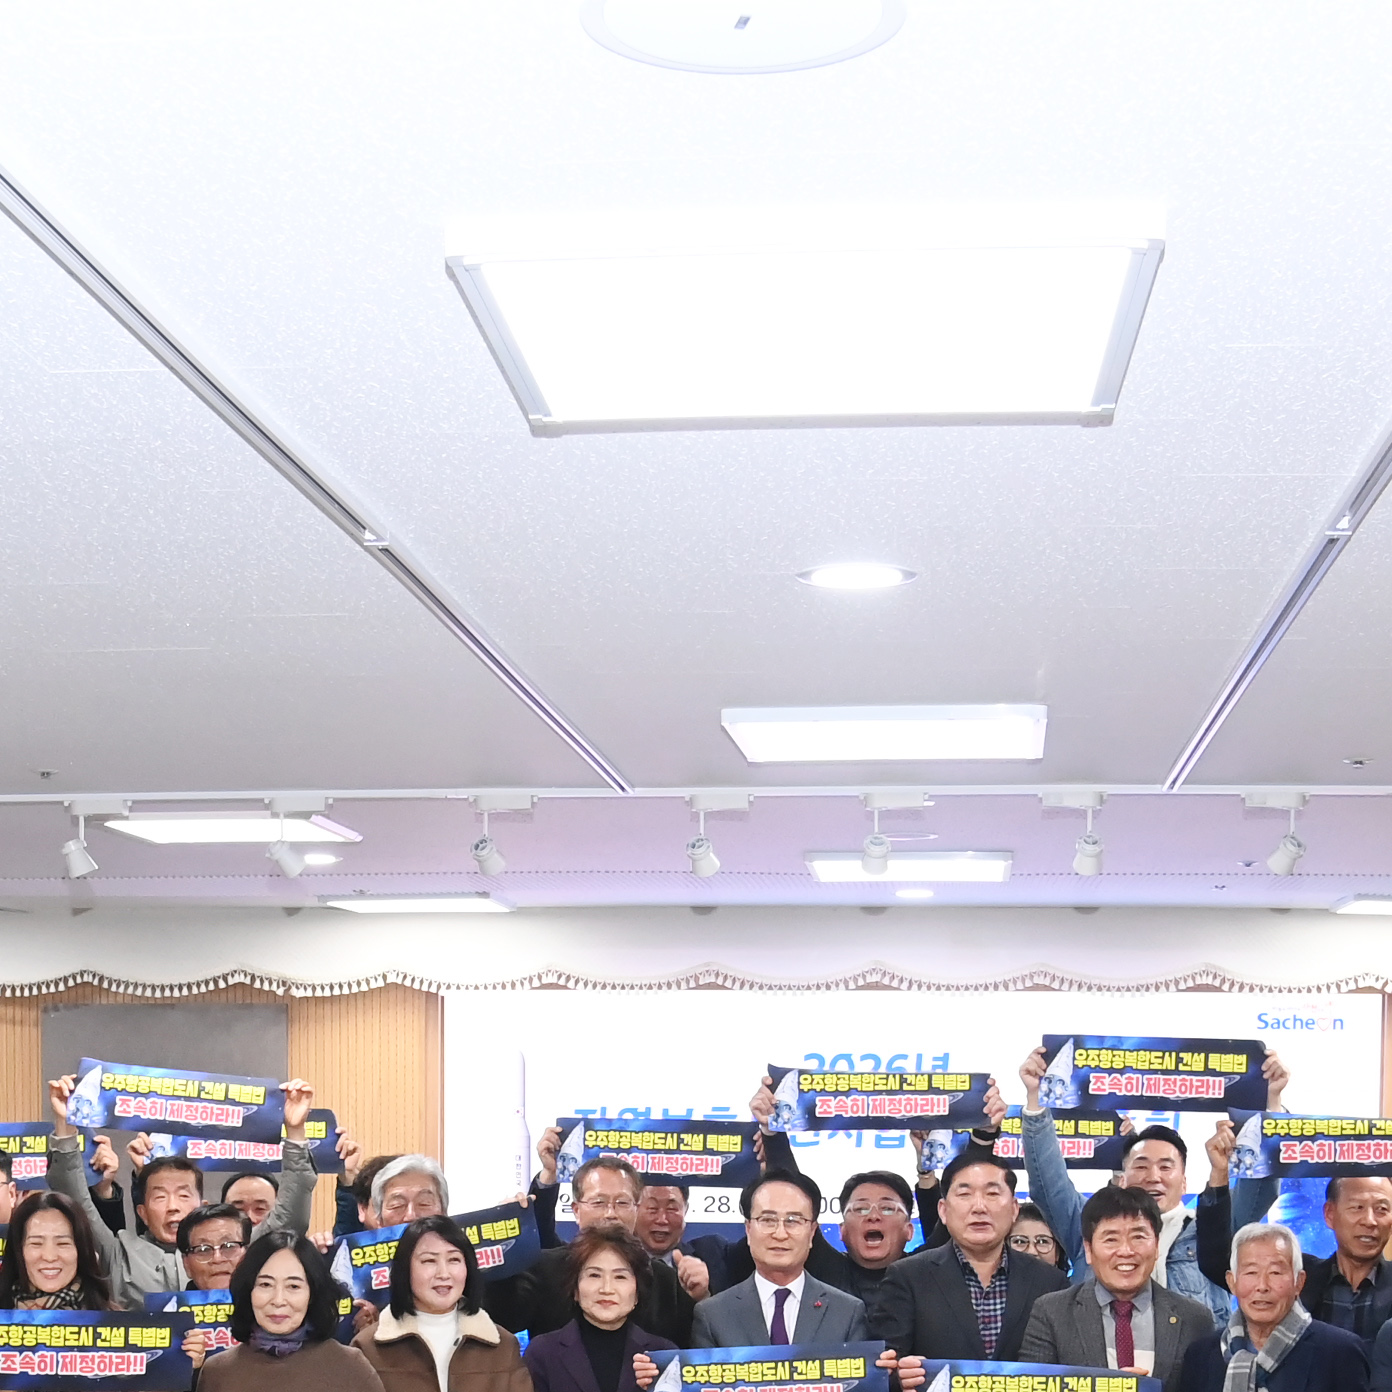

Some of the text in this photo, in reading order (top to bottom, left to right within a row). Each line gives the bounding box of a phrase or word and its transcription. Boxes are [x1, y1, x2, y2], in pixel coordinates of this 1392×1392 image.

[1075, 1049, 1248, 1073] 우주항공복합도시 건설 특별법
[201, 1081, 226, 1100] 건설
[800, 1074, 971, 1092] 우주항공복합도시 건설 특별법
[1089, 1074, 1225, 1099] 조속히 제정하라!!
[115, 1095, 165, 1119] 조속히
[815, 1094, 950, 1117] 조속히 제정하라!!
[1263, 1119, 1371, 1137] 우주항공복합도시
[586, 1130, 742, 1152] 우주항공복합도시 건설 특별법
[1280, 1141, 1336, 1163] 조속히
[647, 1154, 723, 1176] 제정하라!!
[96, 1326, 126, 1348] 건설
[128, 1327, 171, 1348] 특별법
[58, 1352, 149, 1376] 제정하라!!
[683, 1358, 865, 1384] 우주항공복합도시 건설 특별법
